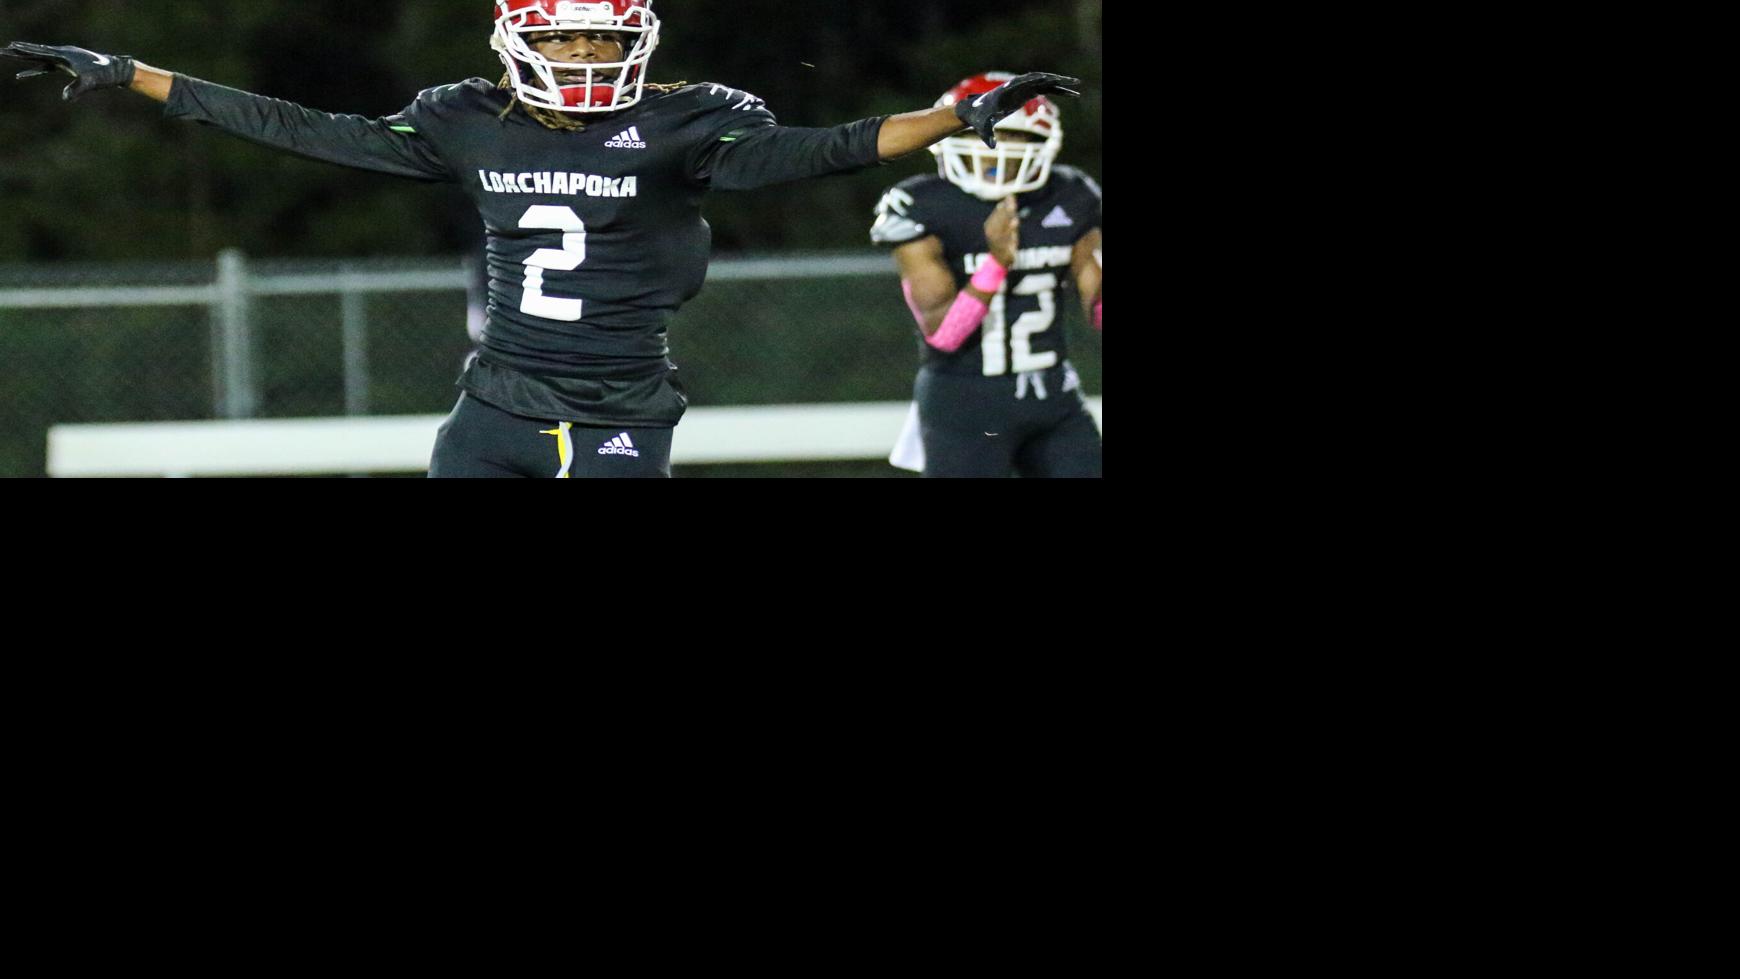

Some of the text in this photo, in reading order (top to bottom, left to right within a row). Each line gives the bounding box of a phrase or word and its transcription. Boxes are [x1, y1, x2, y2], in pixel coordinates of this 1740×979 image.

[605, 139, 646, 149] adidas
[478, 169, 637, 198] LOACHAPOKA
[517, 204, 587, 322] 2
[982, 273, 1057, 376] 12
[597, 445, 639, 457] adidas
